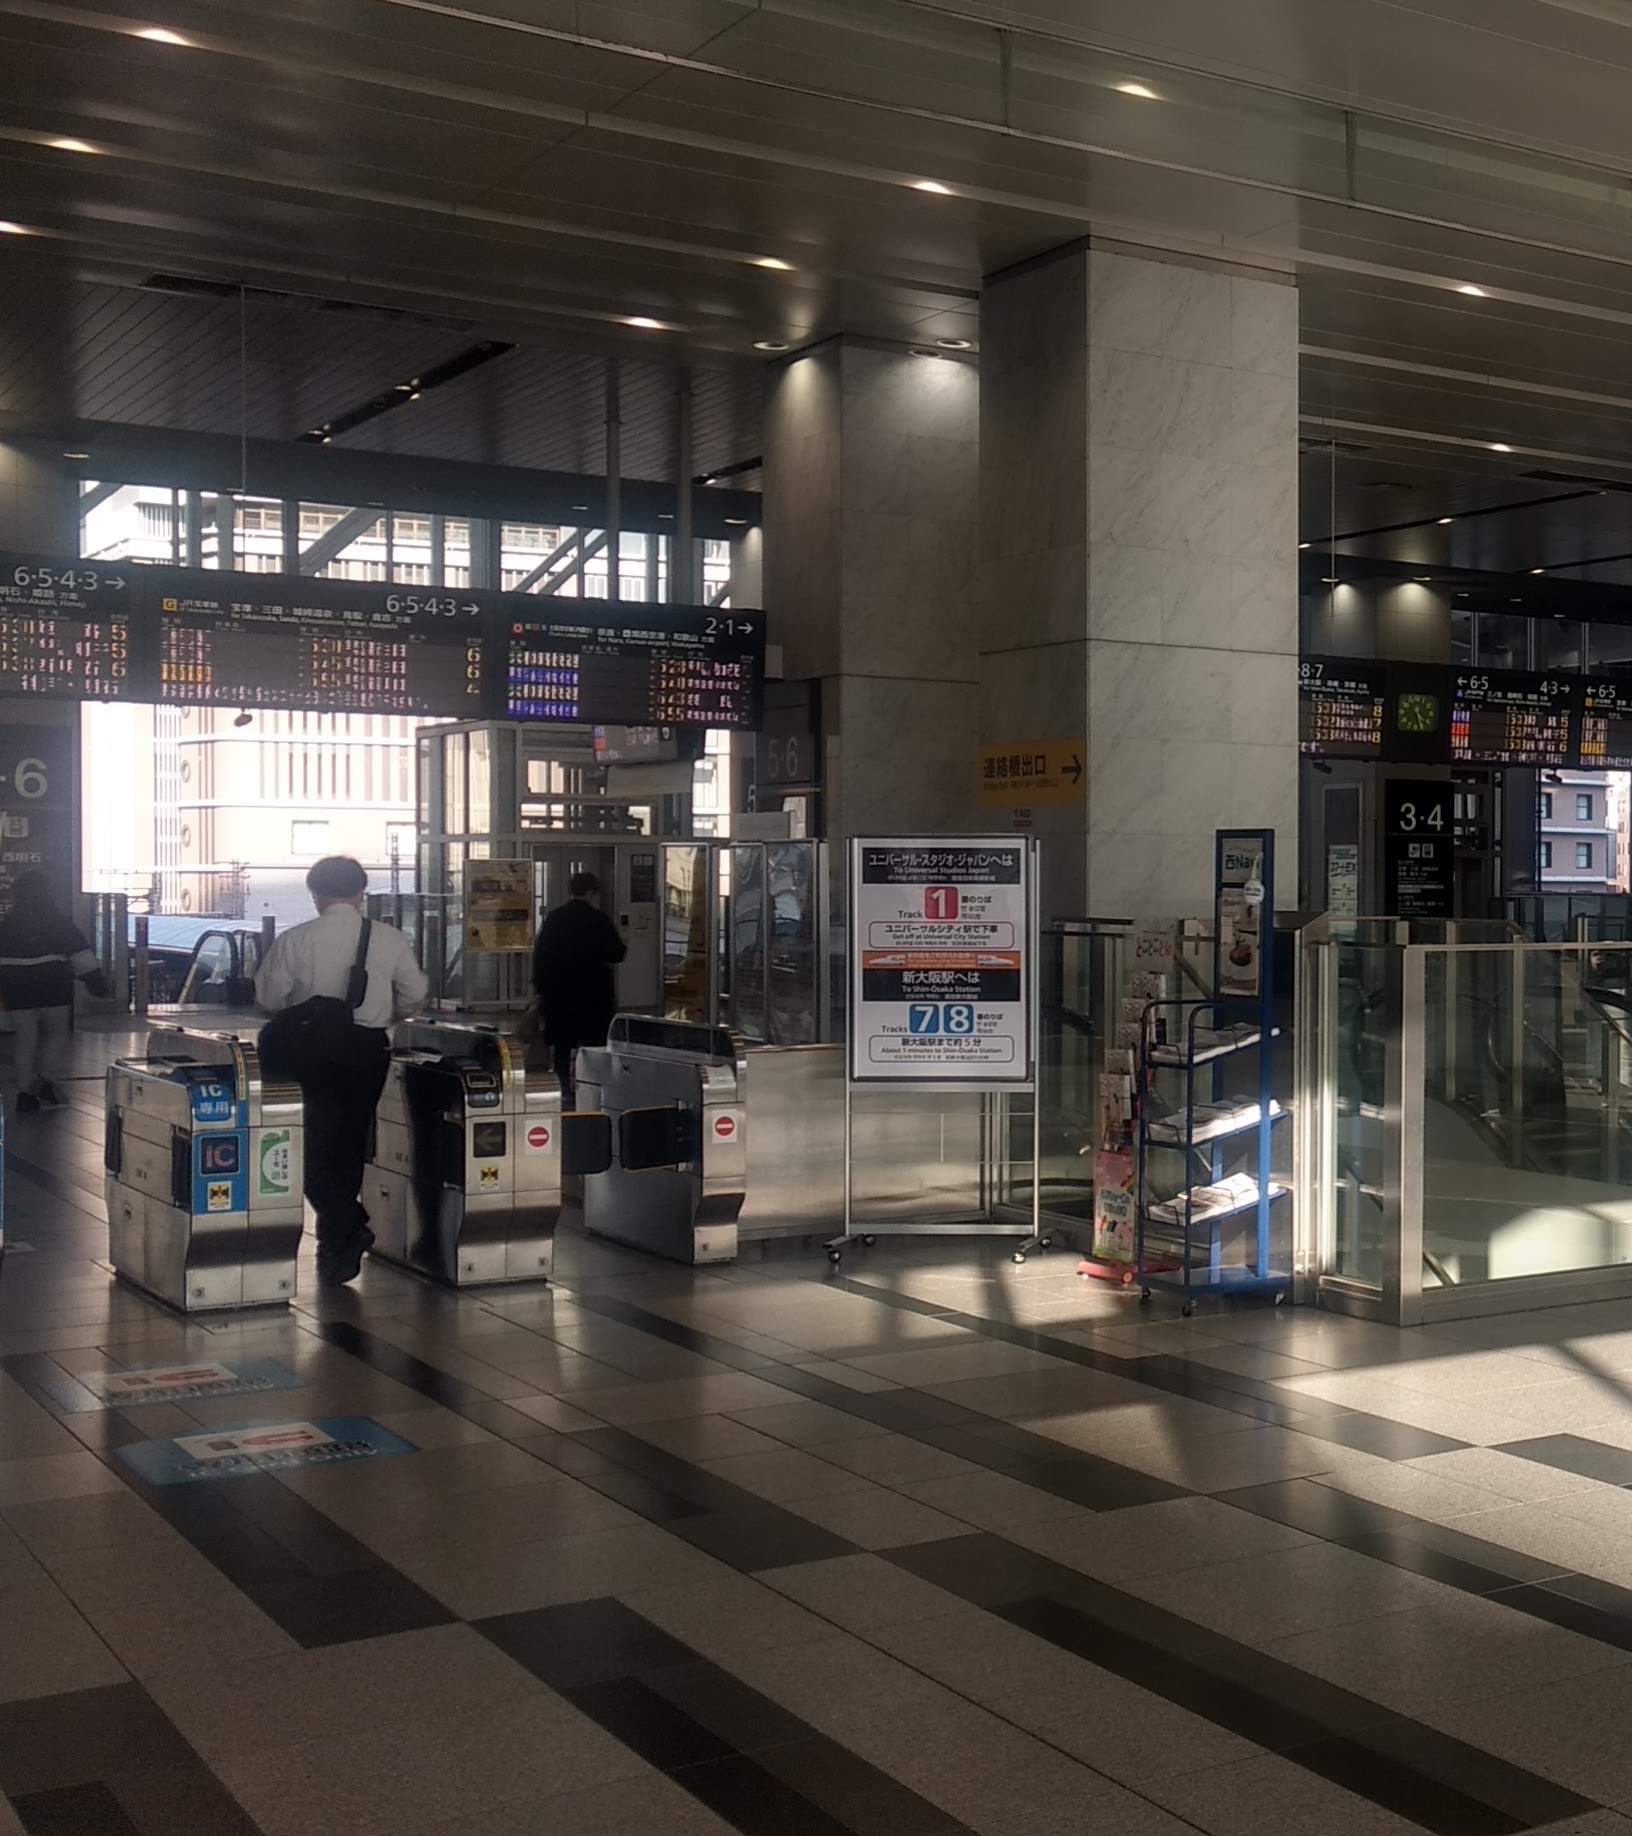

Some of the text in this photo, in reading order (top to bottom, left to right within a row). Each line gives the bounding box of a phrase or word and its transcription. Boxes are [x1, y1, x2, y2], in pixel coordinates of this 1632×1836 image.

[898, 888, 947, 919] Track 1
[885, 925, 998, 934] ユニバーサルシティ駅で下車
[902, 971, 980, 984] 新大阪駅へは
[881, 1006, 969, 1033] Tracks 7 8
[200, 1084, 223, 1098] IC
[199, 1101, 229, 1114] 専用
[206, 1143, 235, 1168] IC
